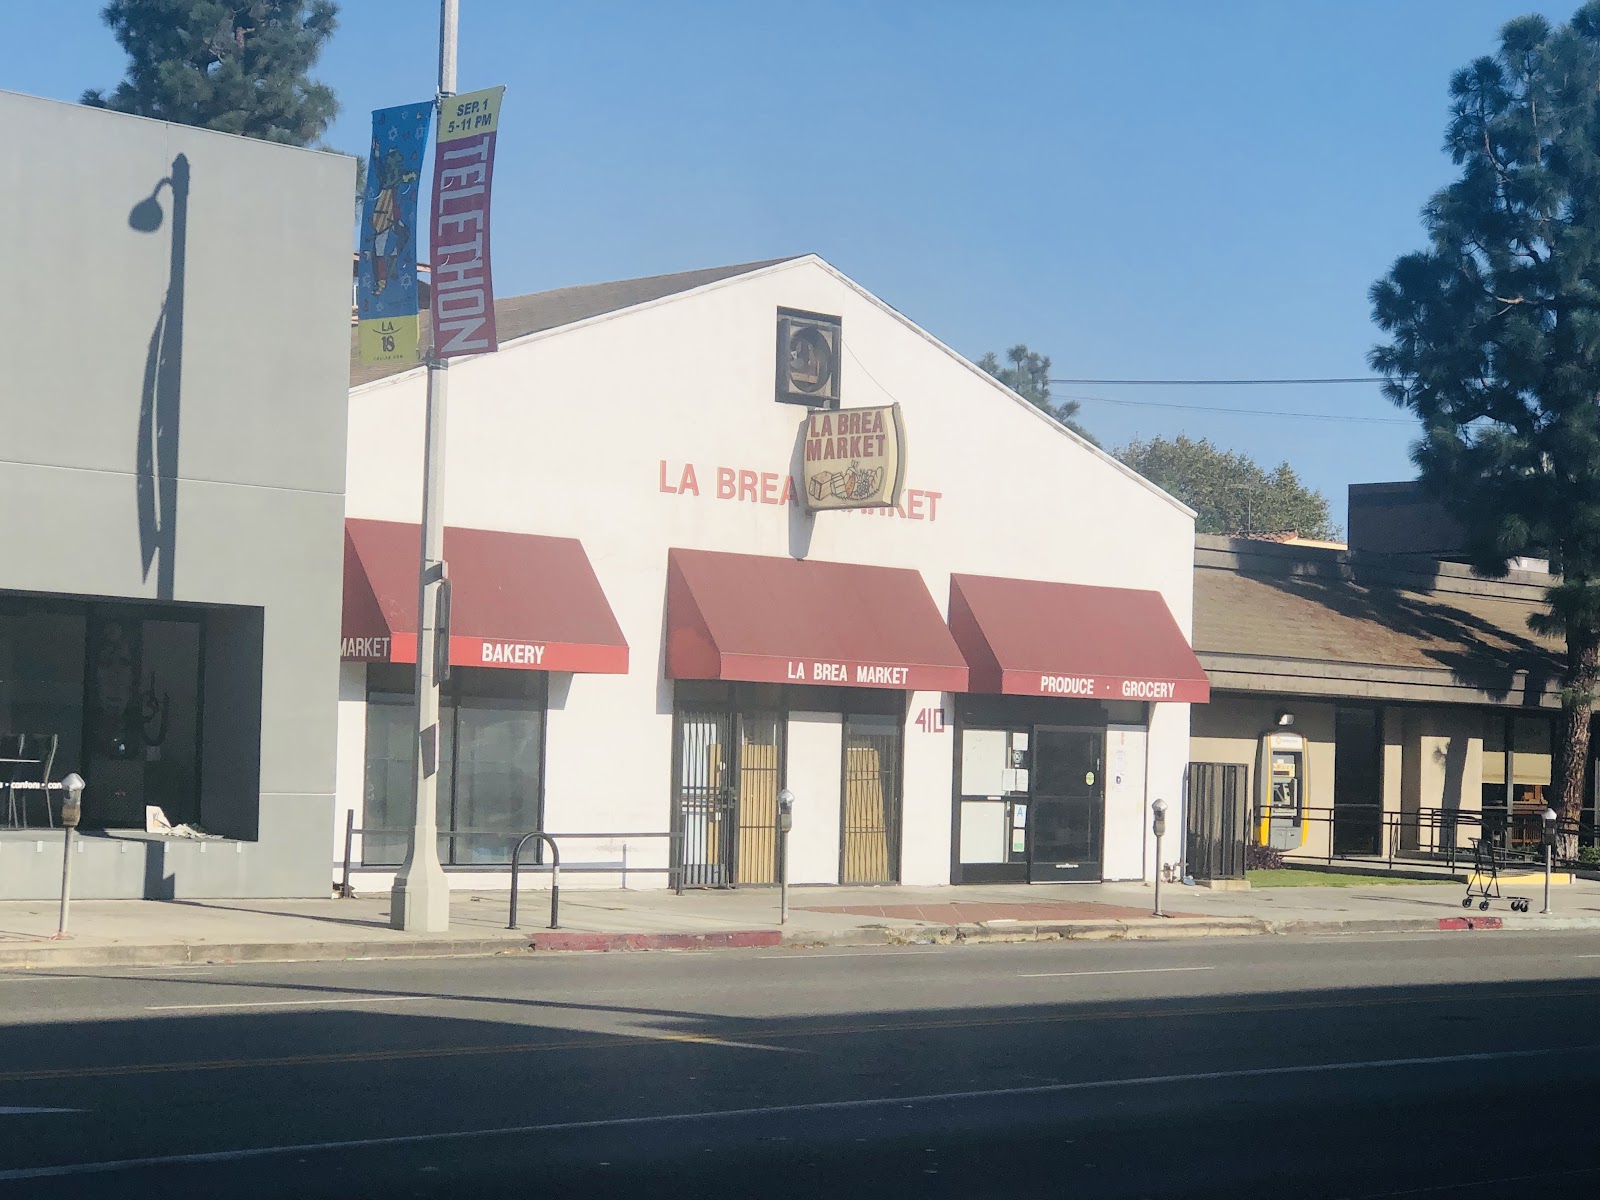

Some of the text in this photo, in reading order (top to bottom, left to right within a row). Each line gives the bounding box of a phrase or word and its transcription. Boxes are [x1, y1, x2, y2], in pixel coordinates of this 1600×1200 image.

[457, 98, 489, 117] SEP. 1
[448, 113, 492, 133] 5-11 PM
[438, 136, 489, 354] TELETHON
[381, 321, 394, 331] LA
[381, 335, 395, 352] 18
[810, 411, 884, 438] LA BREA
[806, 434, 886, 462] MARKET
[659, 460, 700, 496] LA
[716, 466, 799, 507] BREA
[481, 642, 546, 665] BAKERY
[787, 661, 909, 685] LA BREA MARKET
[1040, 675, 1176, 699] PRODUCE GROCERY
[914, 707, 945, 734] 410
[1016, 806, 1024, 817] A
